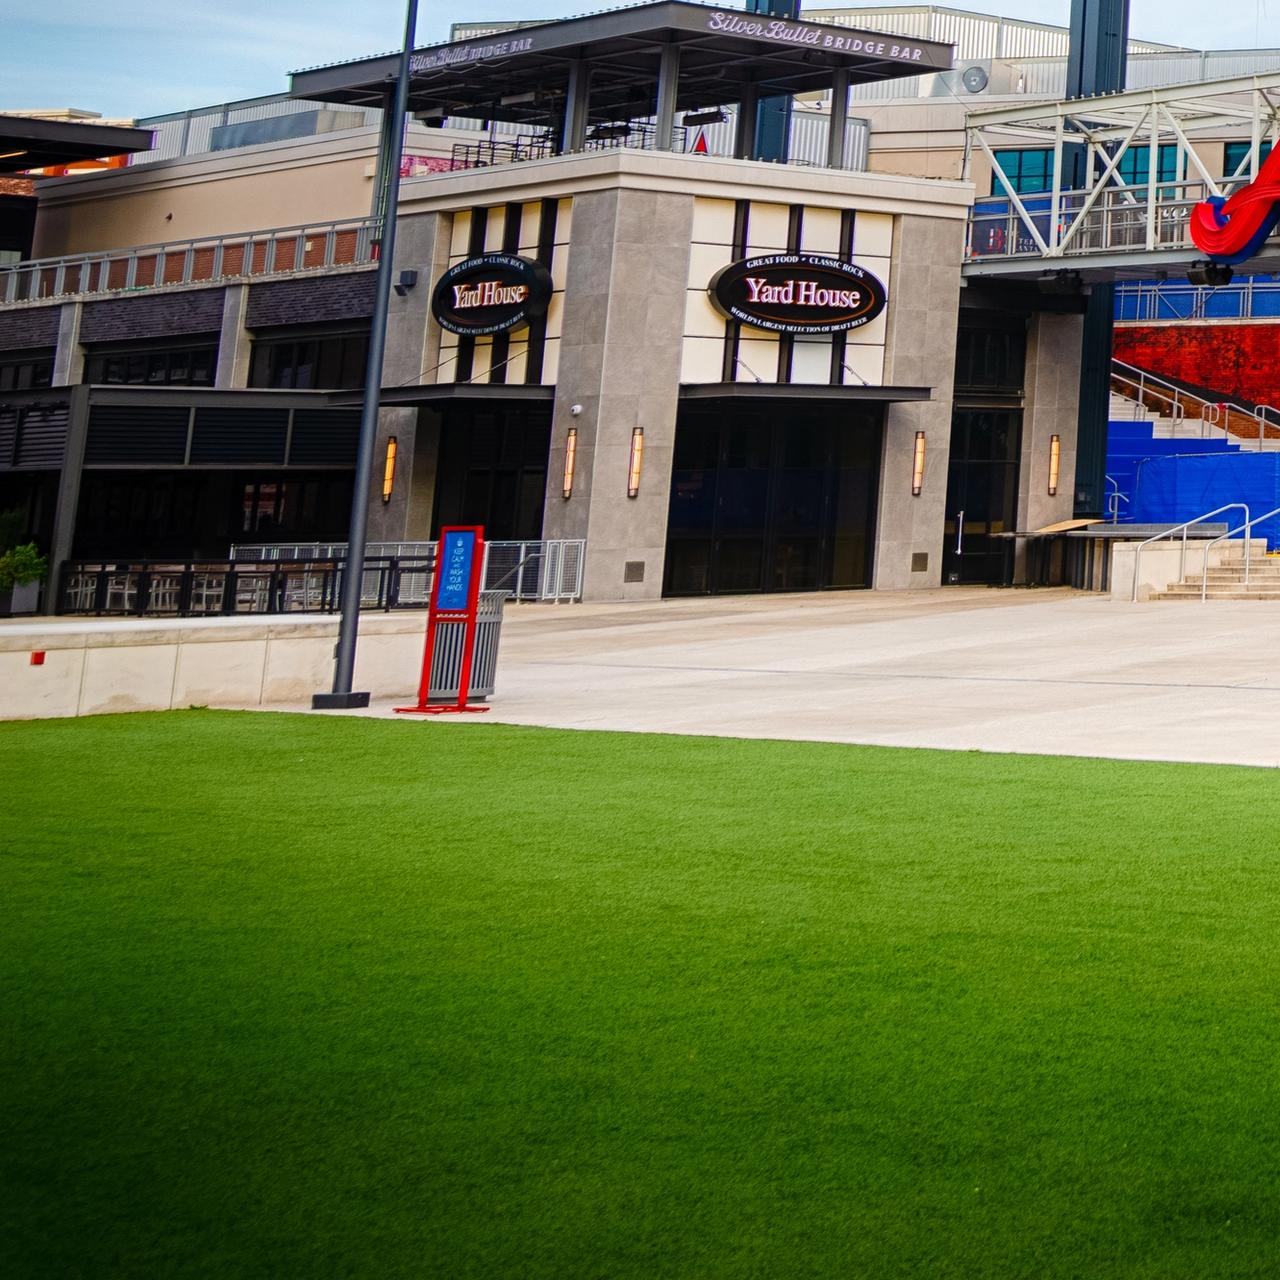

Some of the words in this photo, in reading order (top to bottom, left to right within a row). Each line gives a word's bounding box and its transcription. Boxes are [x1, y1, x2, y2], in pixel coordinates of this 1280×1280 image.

[469, 42, 508, 60] BRIDGE
[509, 38, 533, 53] BAR
[709, 12, 763, 36] Silver
[763, 20, 820, 45] Bullet
[823, 35, 885, 55] BRIDGE
[889, 45, 923, 61] BAR
[747, 257, 774, 268] GREAT
[809, 257, 842, 270] CLASSIC
[843, 263, 865, 278] ROCK
[453, 282, 480, 309] Yard
[482, 281, 526, 306] House
[746, 278, 794, 304] Yard
[797, 281, 861, 308] House
